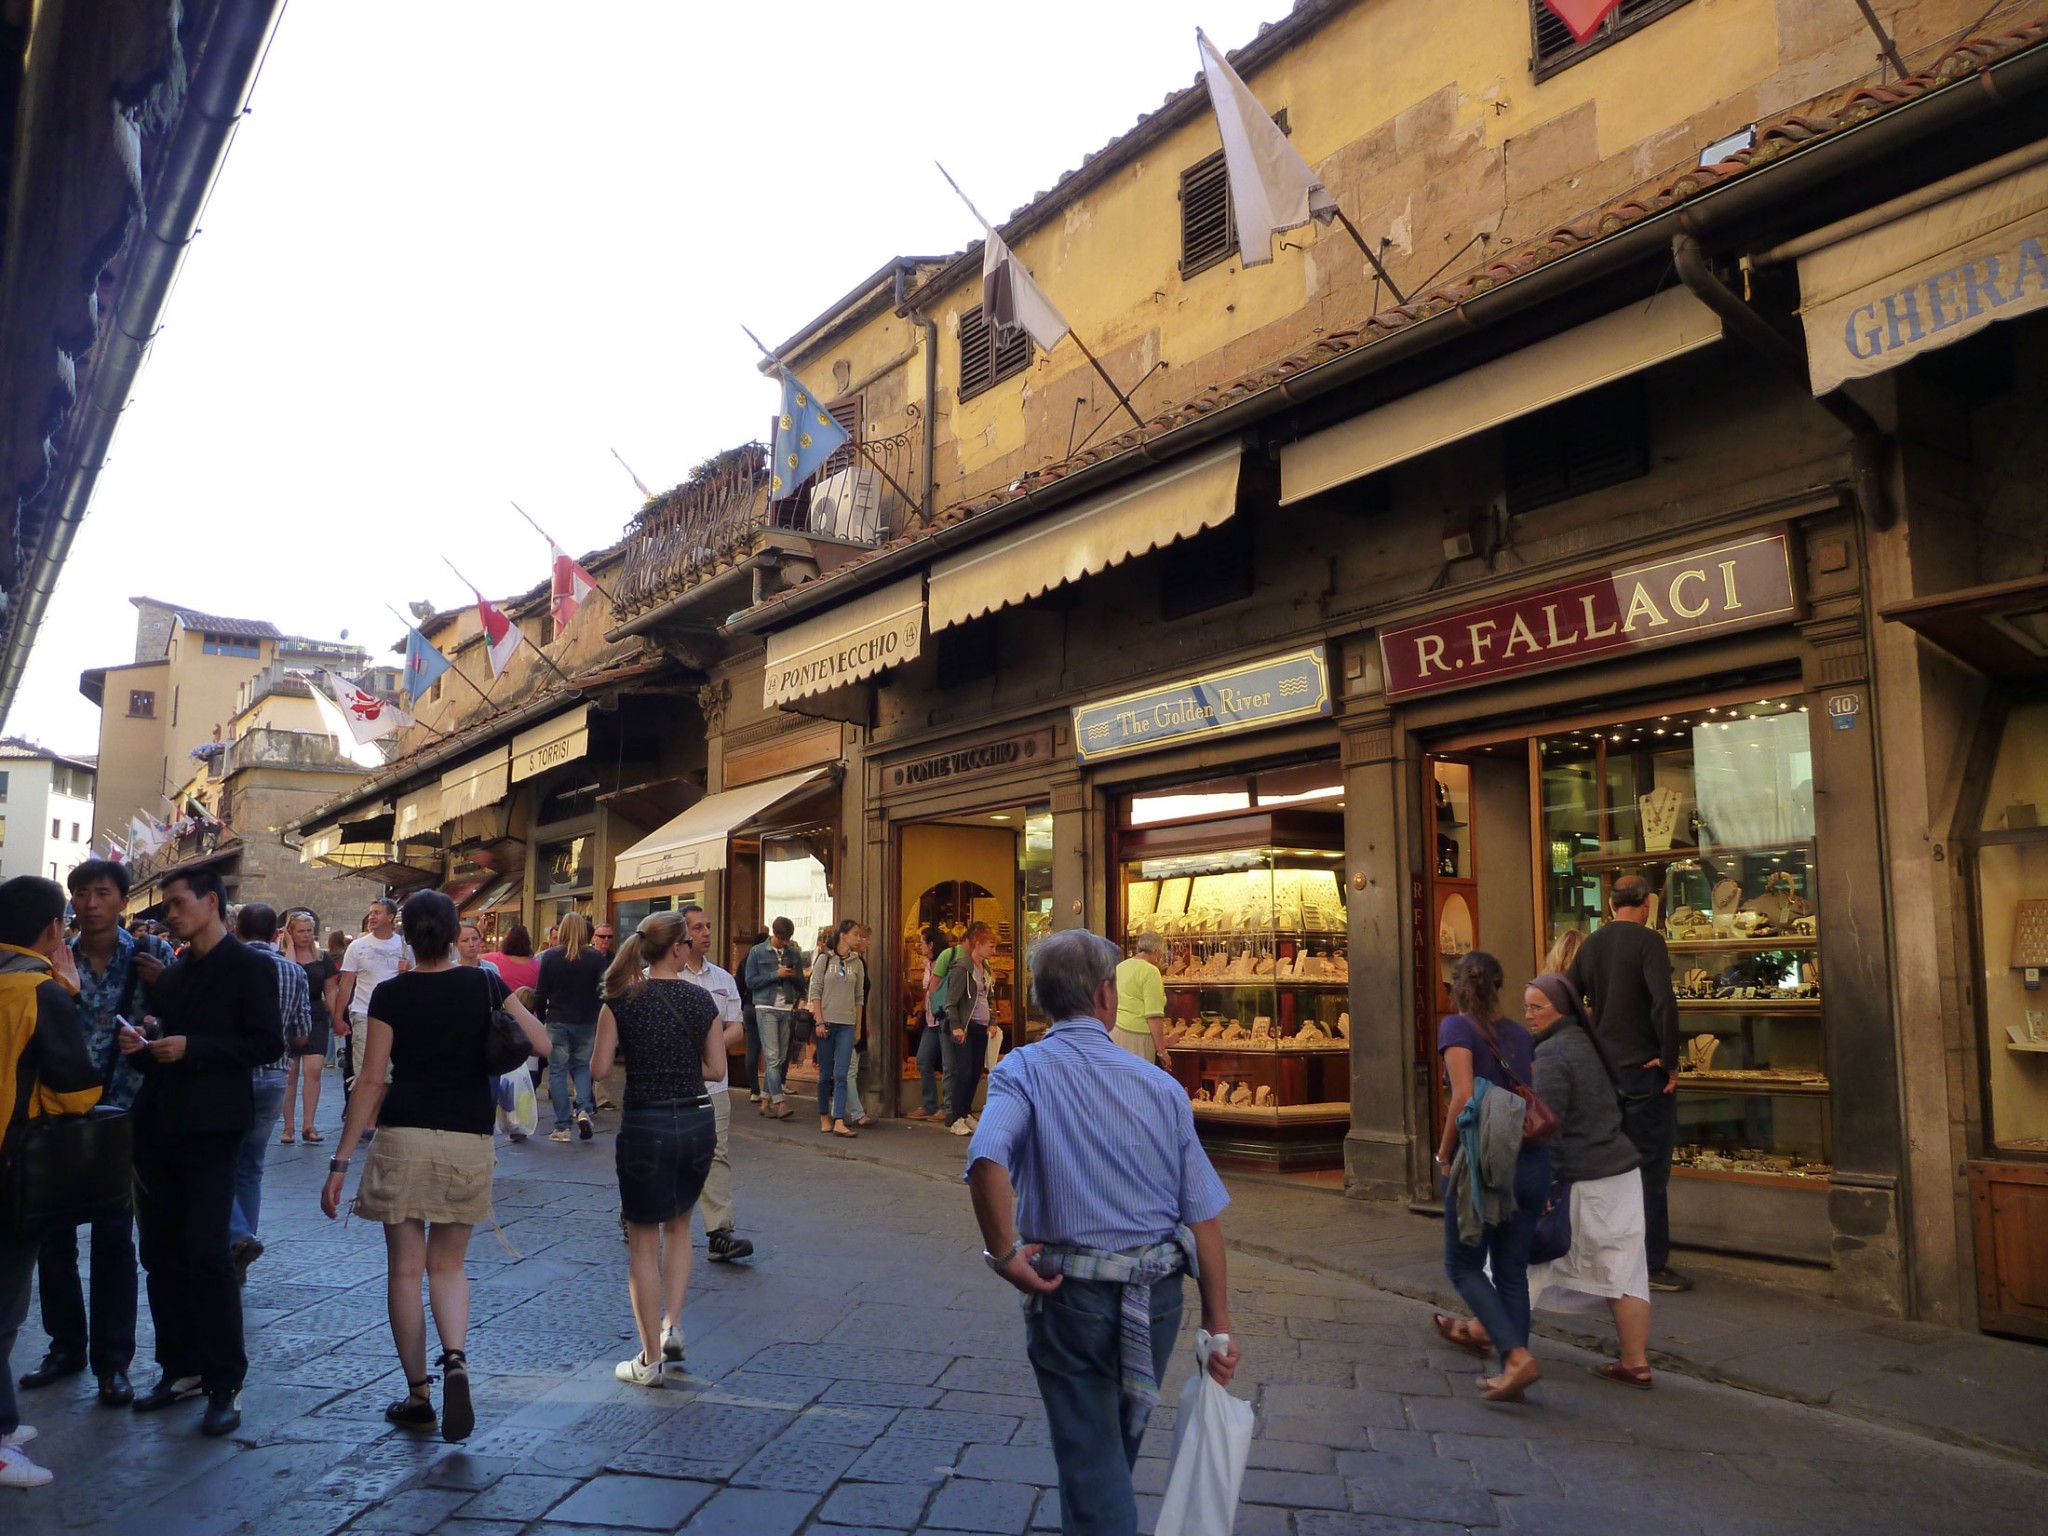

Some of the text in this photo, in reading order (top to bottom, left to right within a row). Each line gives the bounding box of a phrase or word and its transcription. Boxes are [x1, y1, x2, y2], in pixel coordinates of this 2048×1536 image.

[1413, 560, 1742, 678] R.FALLACI
[780, 631, 899, 692] PONTEVECCHIO
[1117, 687, 1272, 737] The Golden River
[1834, 697, 1852, 714] 10
[538, 738, 570, 768] TORRISI
[906, 756, 951, 784] PONTE
[951, 741, 1019, 774] VECCHIO
[1932, 843, 1945, 862] 8
[829, 964, 853, 975] FIH
